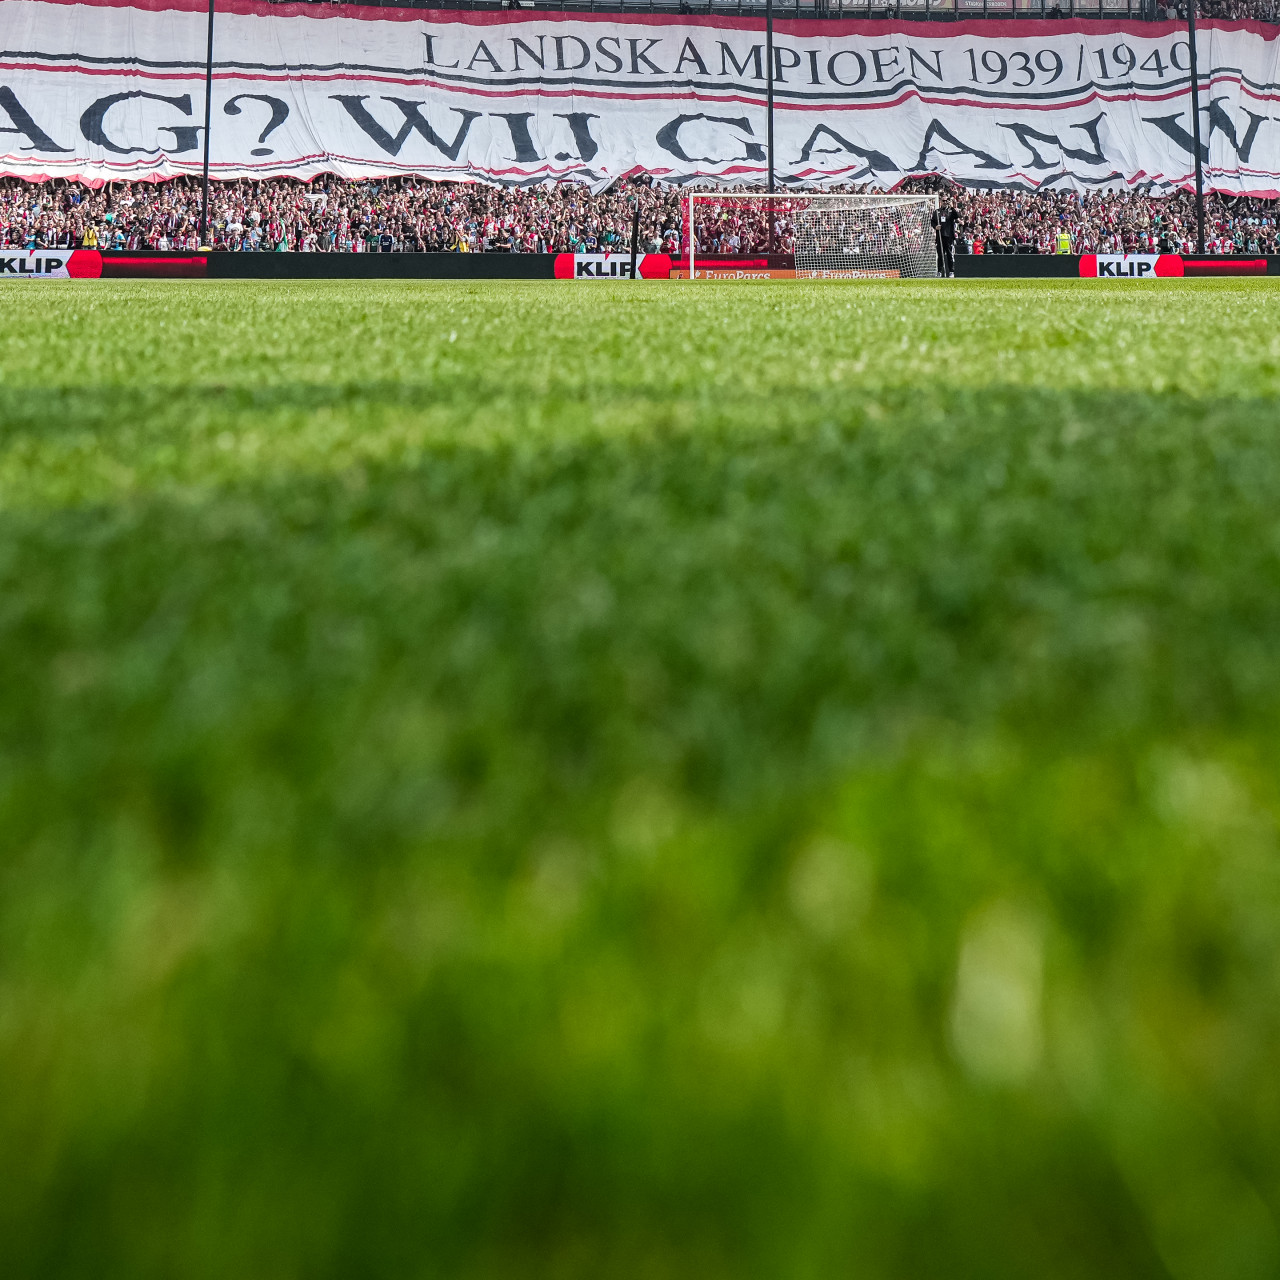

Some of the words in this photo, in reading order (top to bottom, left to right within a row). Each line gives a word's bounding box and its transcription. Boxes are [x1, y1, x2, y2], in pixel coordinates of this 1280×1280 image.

[422, 31, 945, 86] LANDSKAMPIOEN
[330, 94, 600, 163] WIJ
[656, 112, 1108, 173] GAAN
[577, 261, 633, 277] KLIP
[1100, 262, 1151, 276] KLIP
